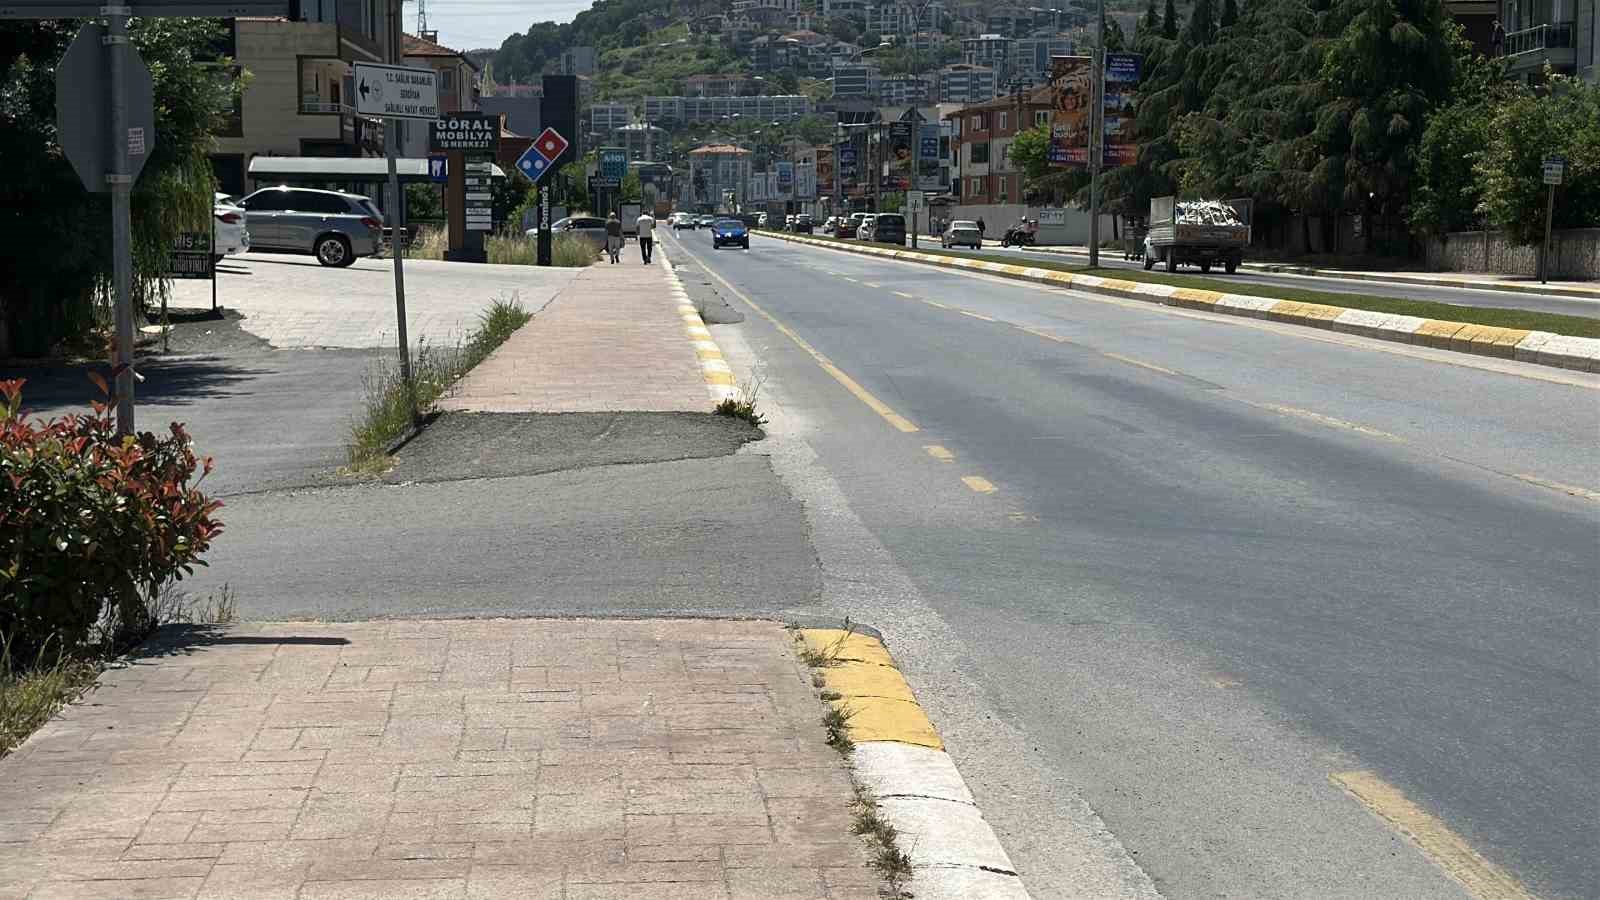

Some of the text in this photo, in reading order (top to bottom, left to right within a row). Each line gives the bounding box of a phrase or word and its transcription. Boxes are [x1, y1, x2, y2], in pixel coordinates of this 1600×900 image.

[436, 117, 493, 130] GÖRAL
[436, 130, 493, 140] MOBİLYA
[450, 140, 489, 148] MERKEZİ
[540, 185, 549, 230] Domino's
